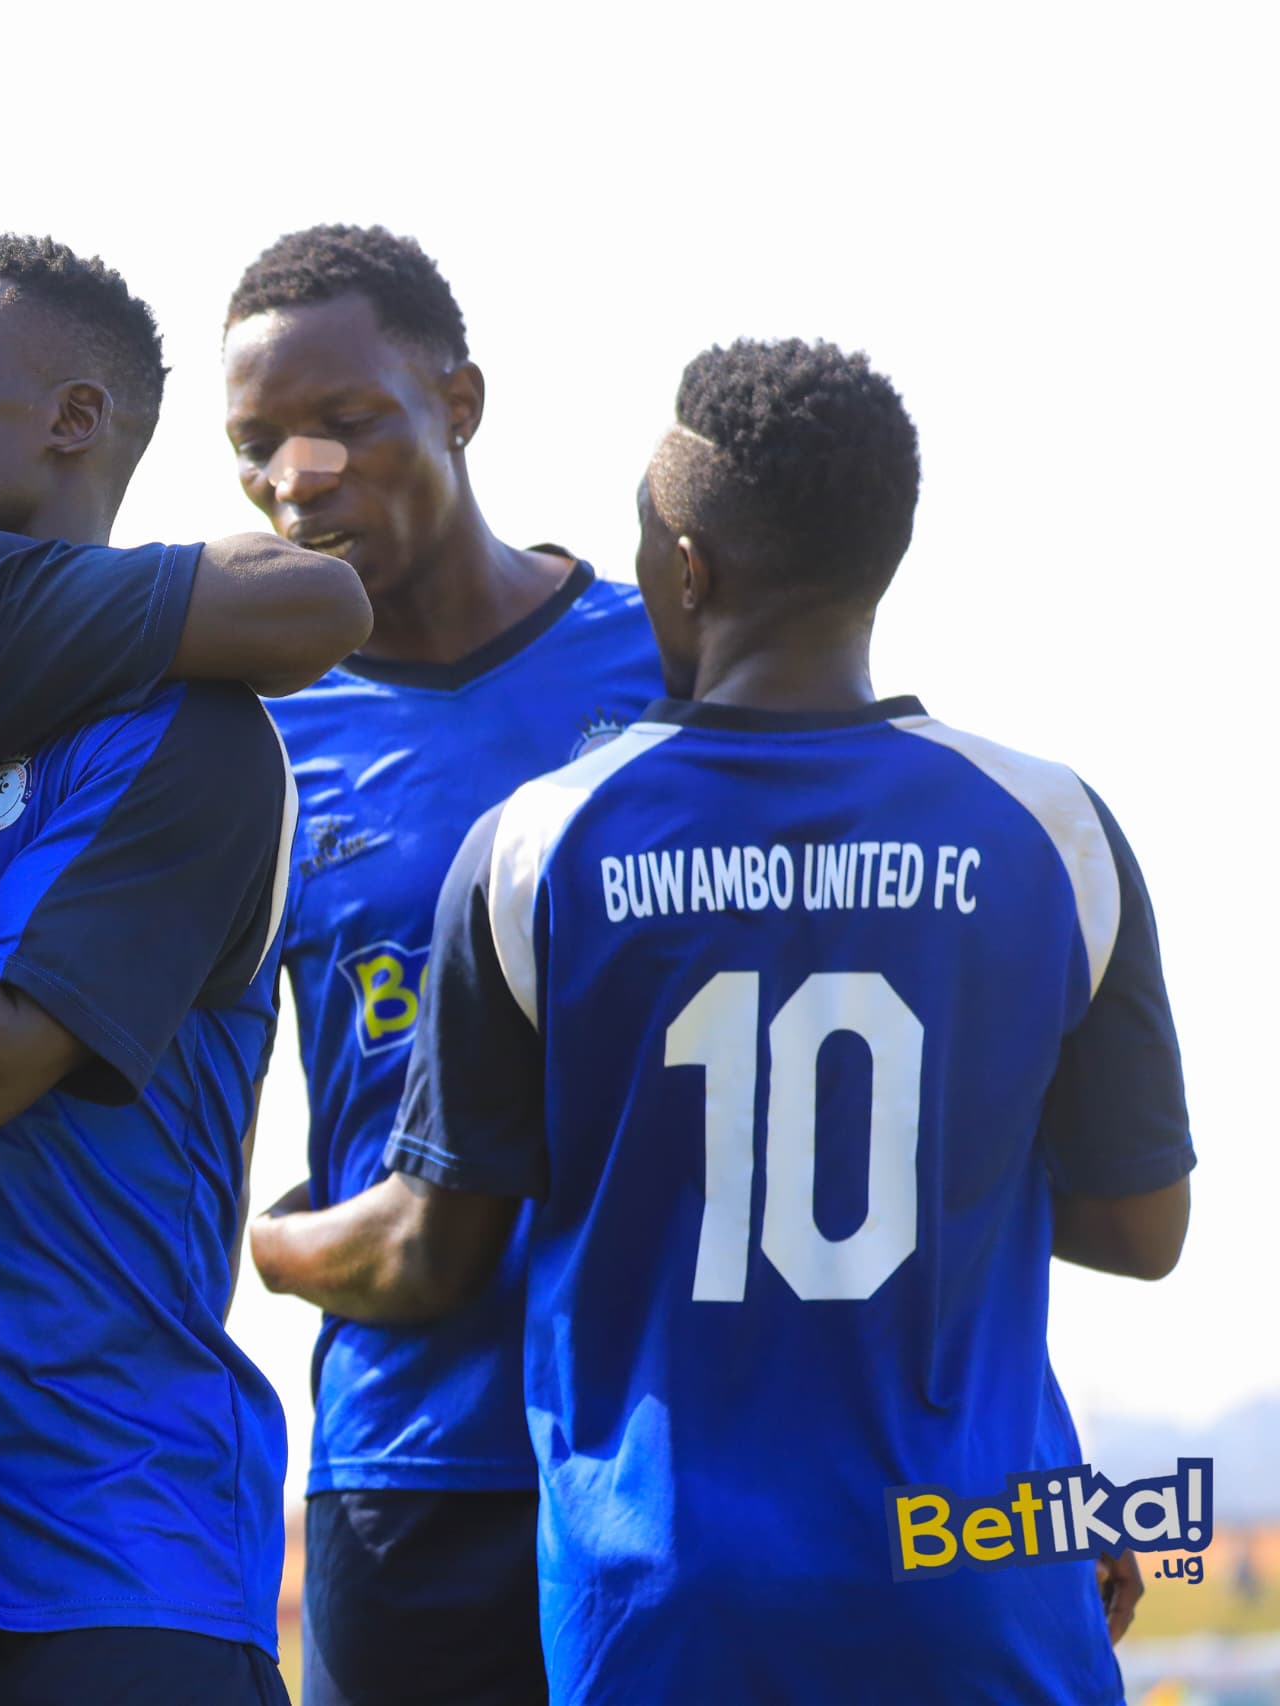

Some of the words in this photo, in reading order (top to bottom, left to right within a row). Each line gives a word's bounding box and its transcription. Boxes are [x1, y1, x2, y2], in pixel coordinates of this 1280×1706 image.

[601, 845, 794, 922] BUWAMBO
[803, 842, 924, 910] UNITED
[934, 845, 981, 914] FC
[355, 955, 429, 1039] B
[664, 971, 924, 1302] 10
